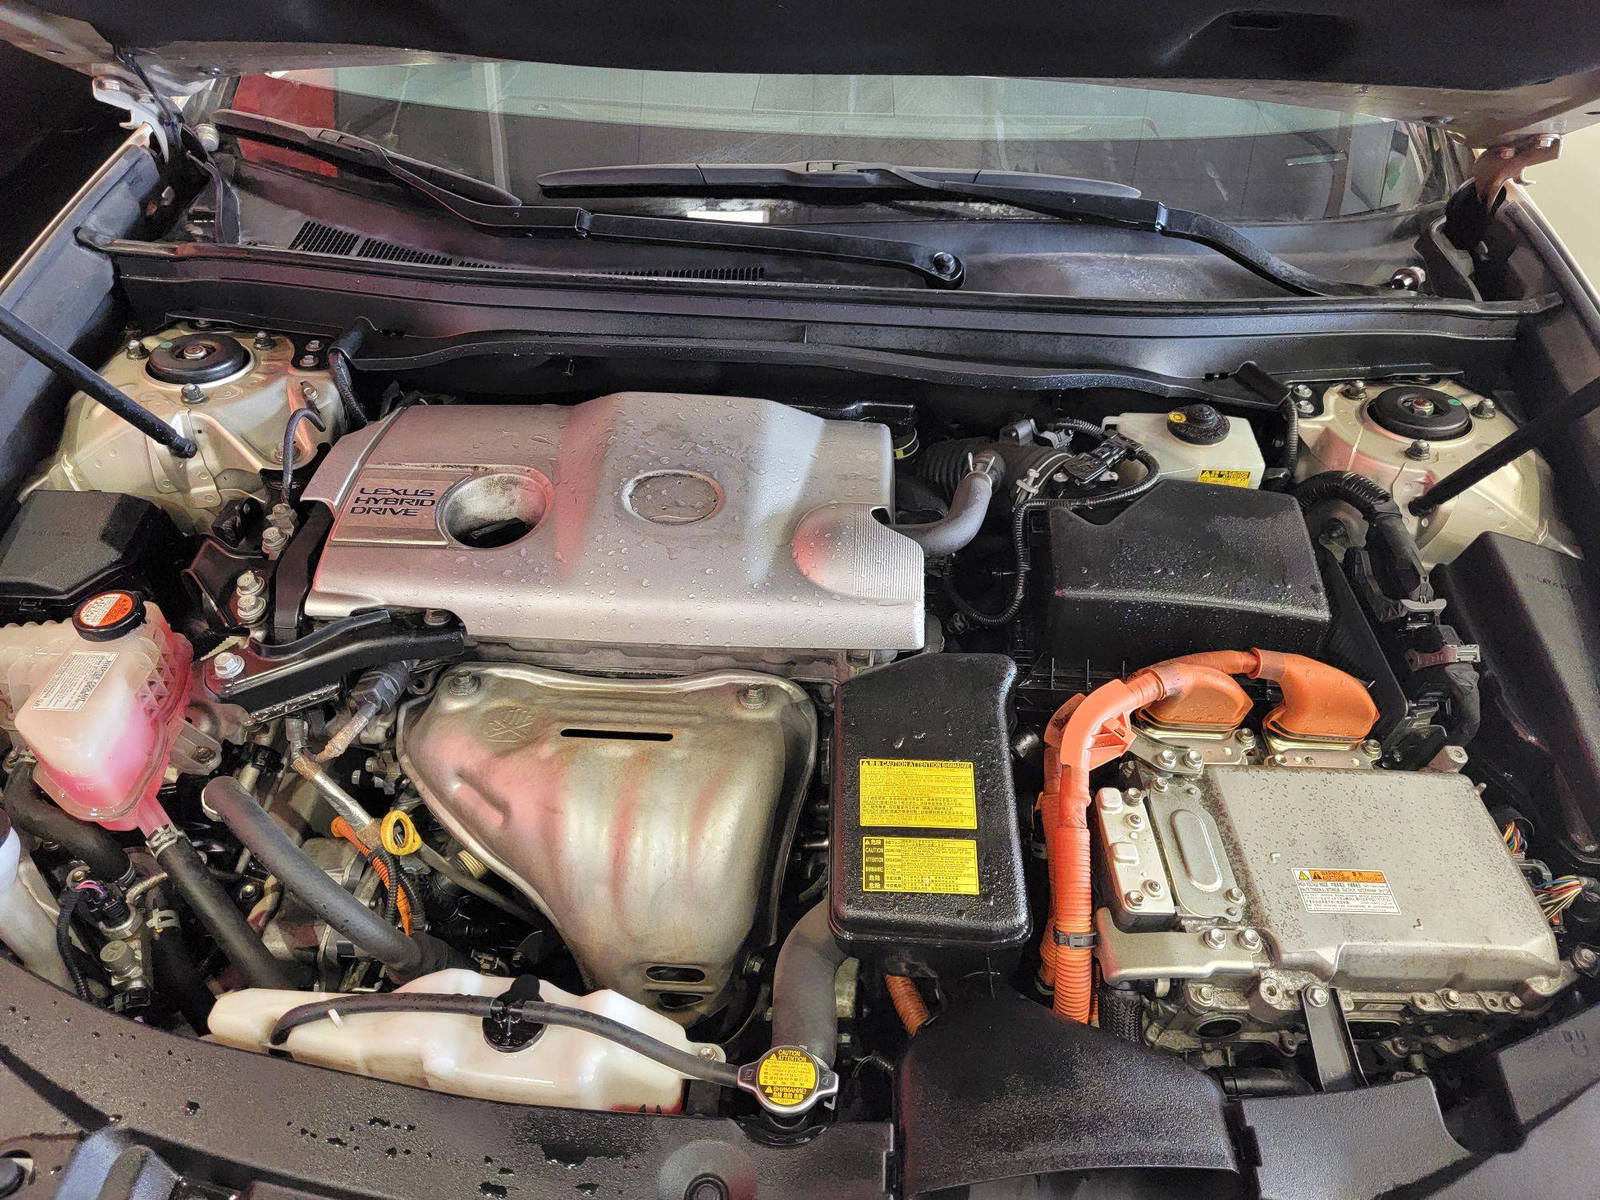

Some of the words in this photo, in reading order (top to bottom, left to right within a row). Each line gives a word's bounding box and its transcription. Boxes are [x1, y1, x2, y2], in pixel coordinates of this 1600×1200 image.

[360, 488, 436, 496] LEXUS
[354, 497, 436, 506] HYBRID
[350, 507, 419, 516] DRIVE
